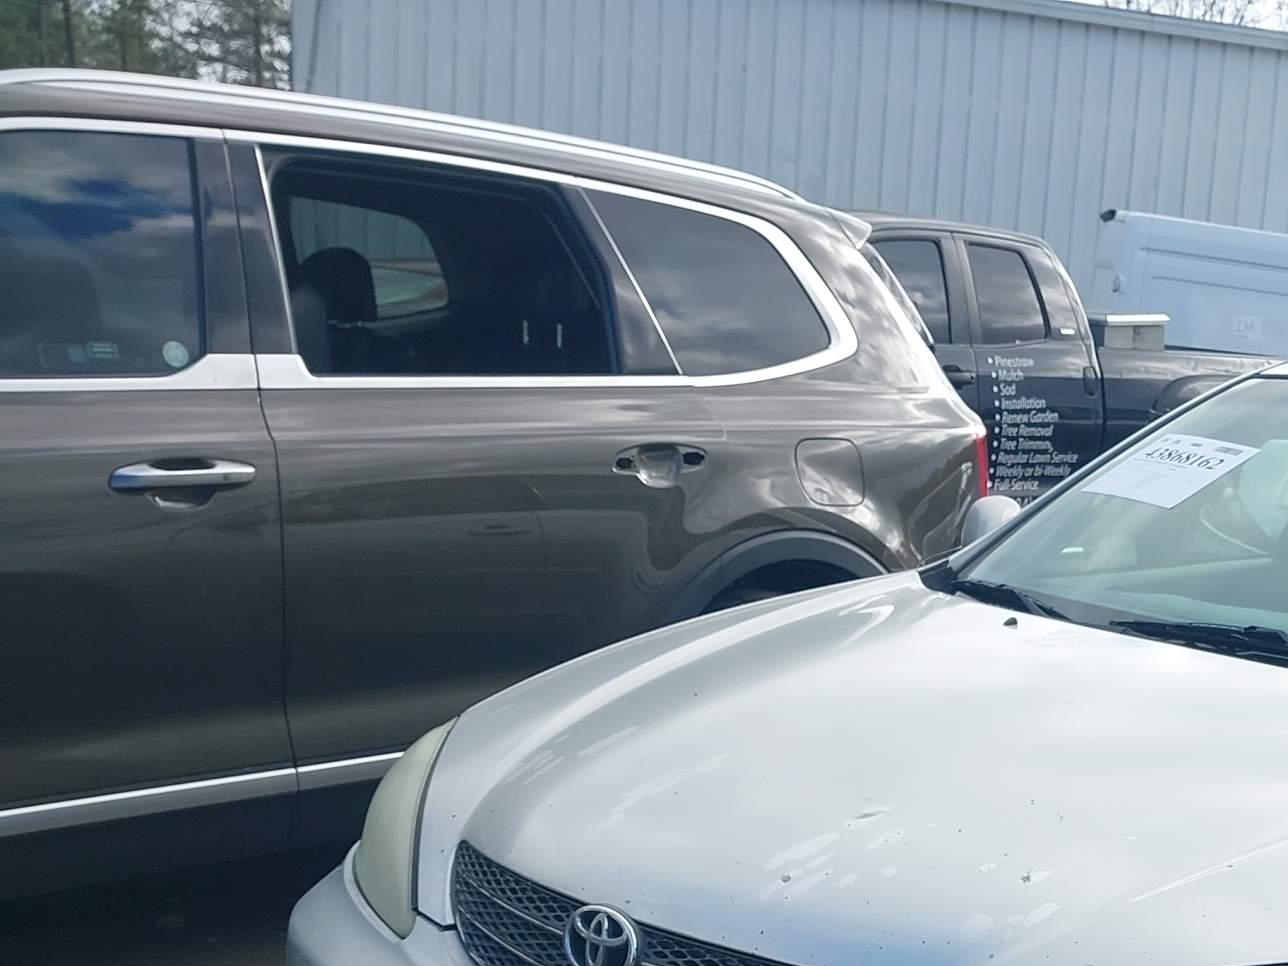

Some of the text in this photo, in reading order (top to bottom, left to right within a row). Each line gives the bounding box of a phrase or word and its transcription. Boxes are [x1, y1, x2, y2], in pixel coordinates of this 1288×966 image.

[998, 368, 1024, 381] Mulch
[999, 383, 1016, 396] Sod
[1001, 396, 1046, 409] Installation
[1002, 409, 1059, 424] Renew Garden
[1001, 423, 1054, 436] Tree Removal
[1000, 438, 1017, 450] Tree
[997, 451, 1079, 466] Regular Lawn Service
[1145, 447, 1225, 470] 43868162
